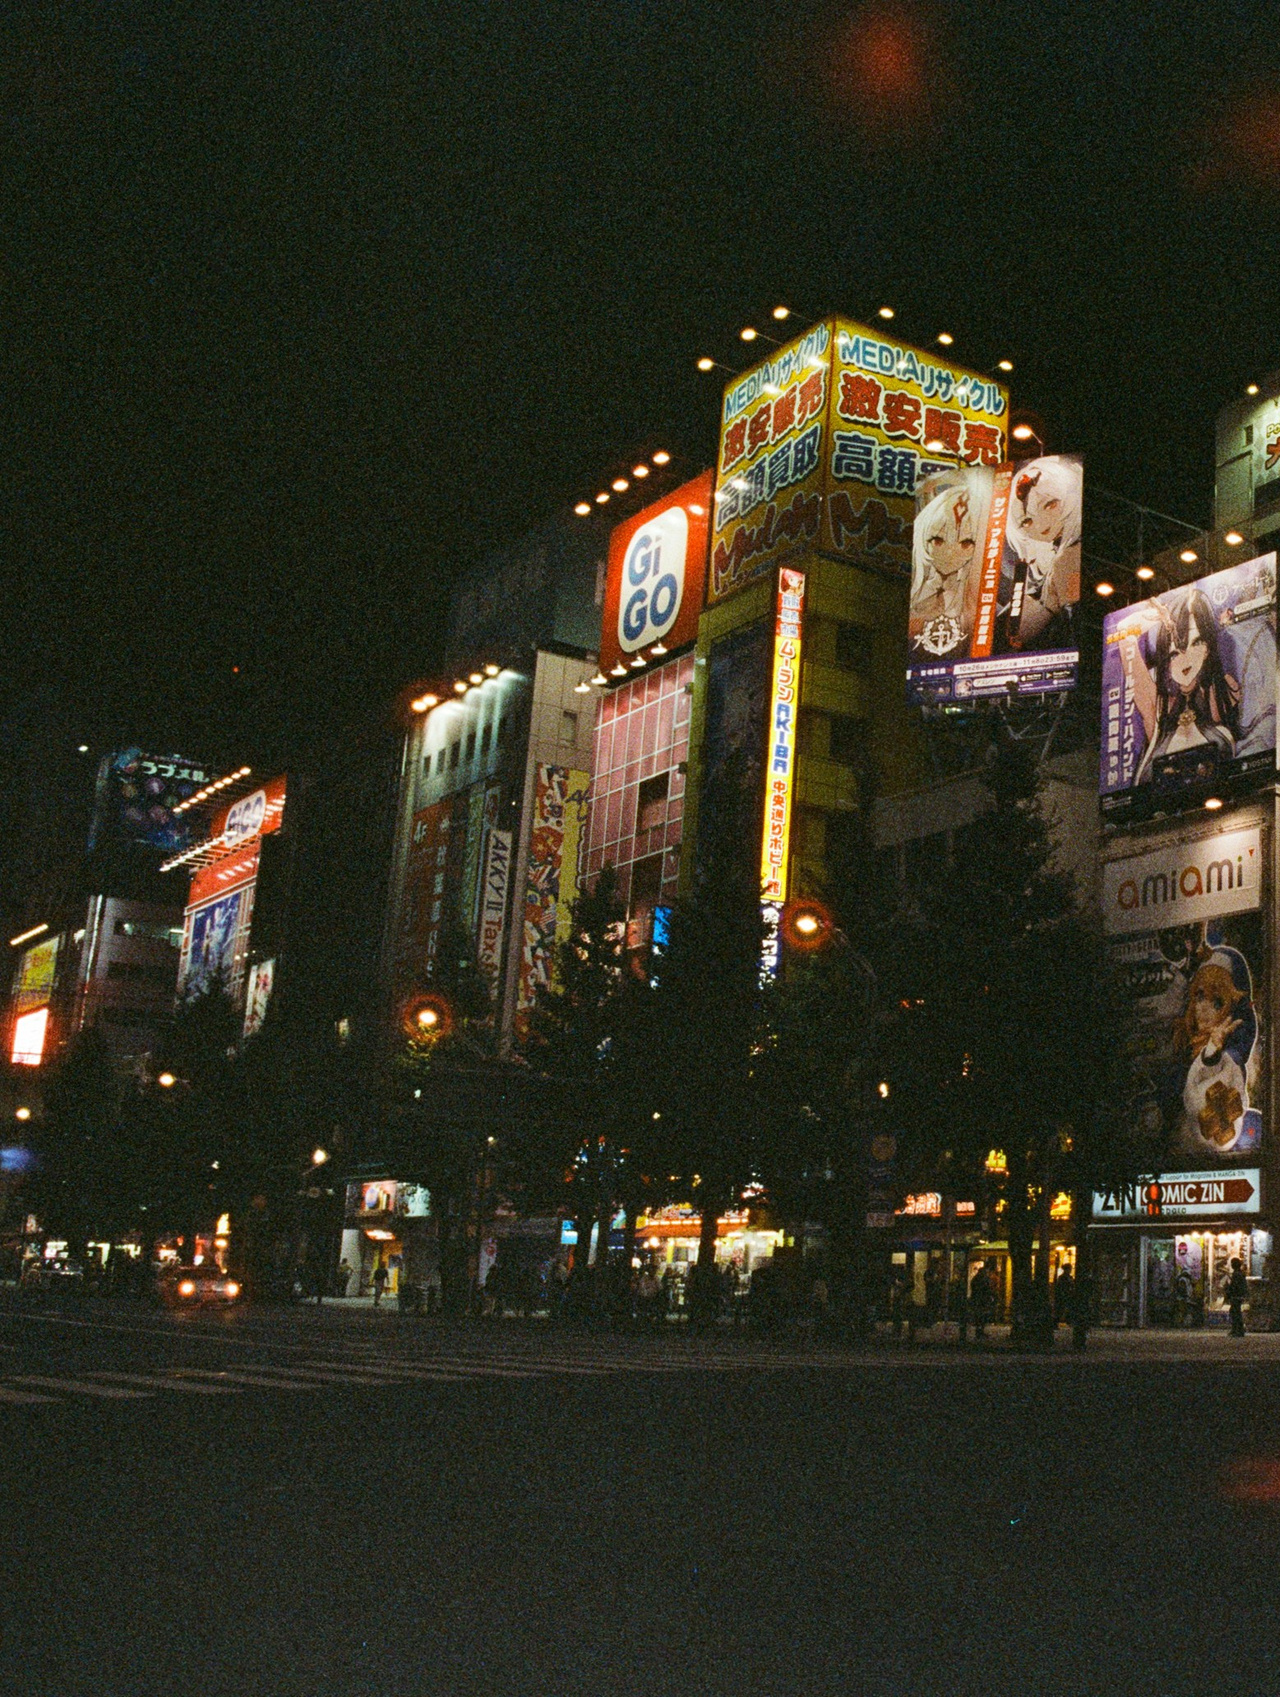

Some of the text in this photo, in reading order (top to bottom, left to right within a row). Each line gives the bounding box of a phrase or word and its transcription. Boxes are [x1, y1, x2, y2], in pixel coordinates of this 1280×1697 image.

[838, 330, 1004, 414] MEDIAリサイクル
[838, 371, 1002, 466] 激安販売
[833, 432, 957, 494] 高額
[1118, 855, 1243, 911] amiami
[1201, 1182, 1224, 1202] ZIN
